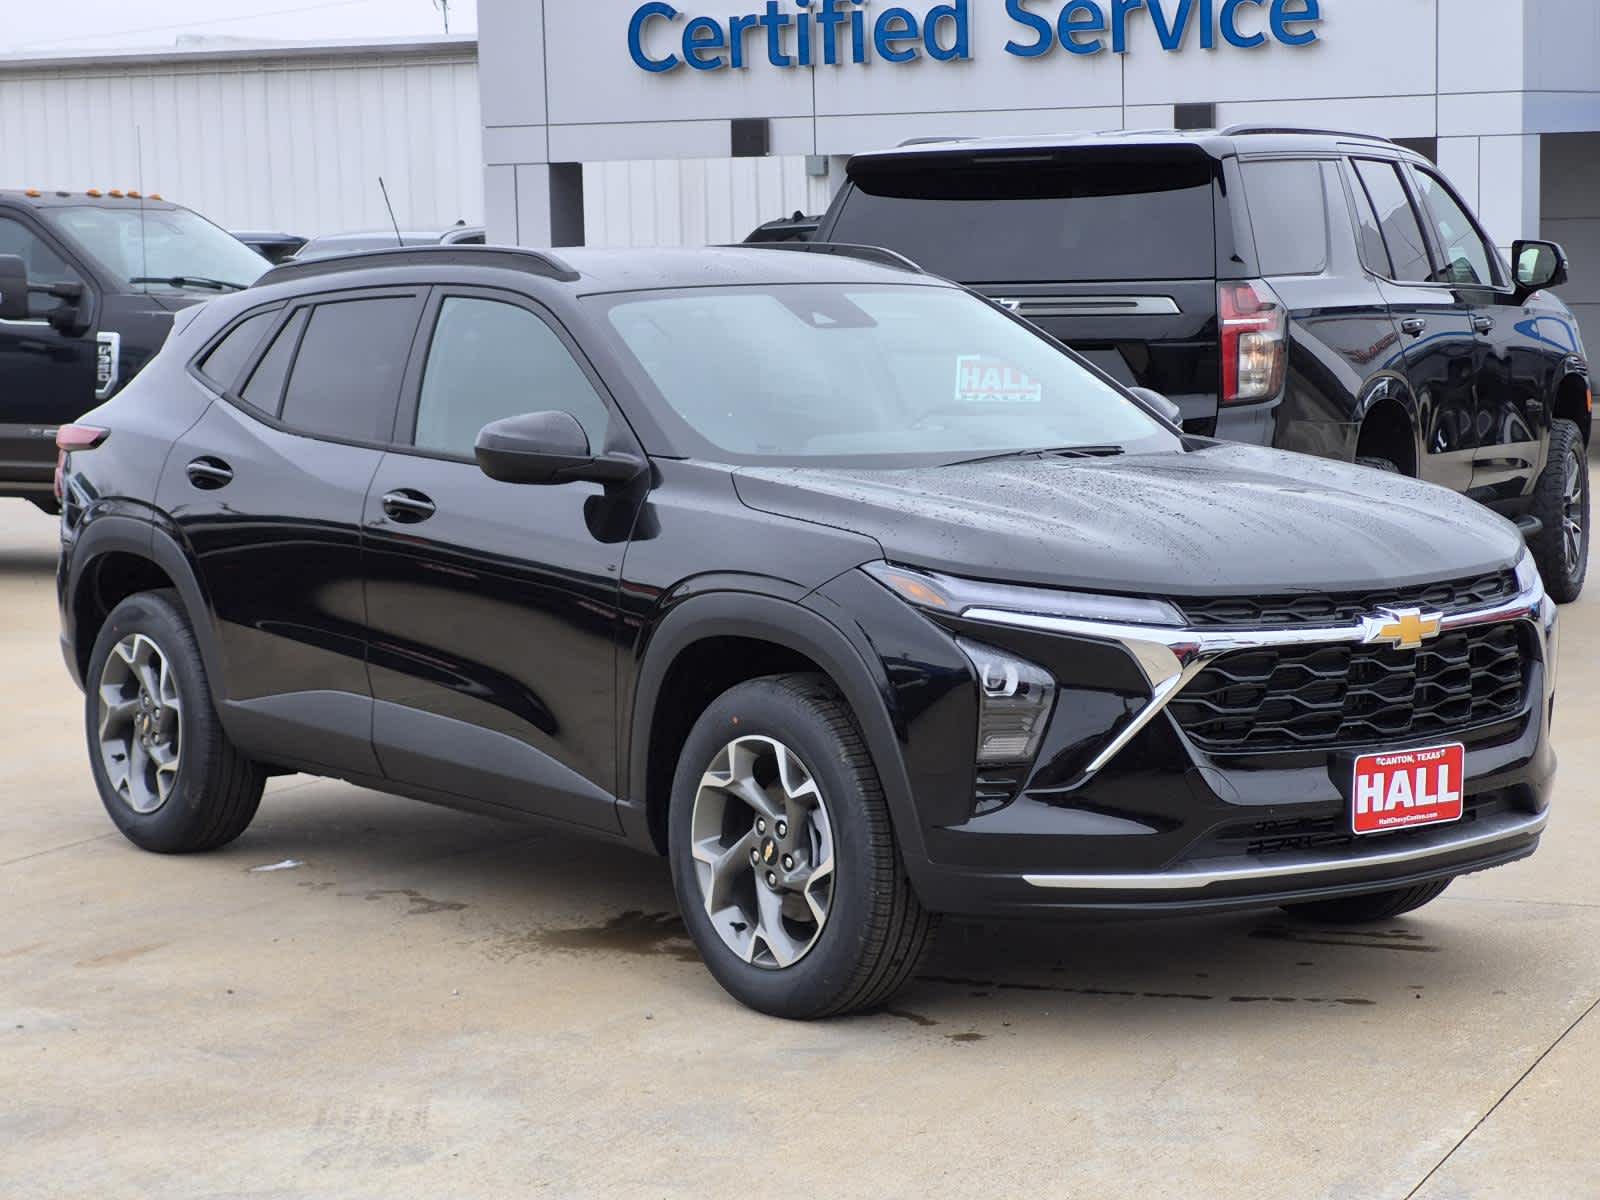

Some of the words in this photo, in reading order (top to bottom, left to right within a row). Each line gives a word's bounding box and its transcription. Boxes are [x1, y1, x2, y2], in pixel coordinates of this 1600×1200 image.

[628, 0, 971, 73] Certified
[1003, 0, 1322, 57] Service
[960, 367, 1034, 392] HALL
[1416, 751, 1441, 761] TEXAS
[1356, 764, 1459, 814] HALL
